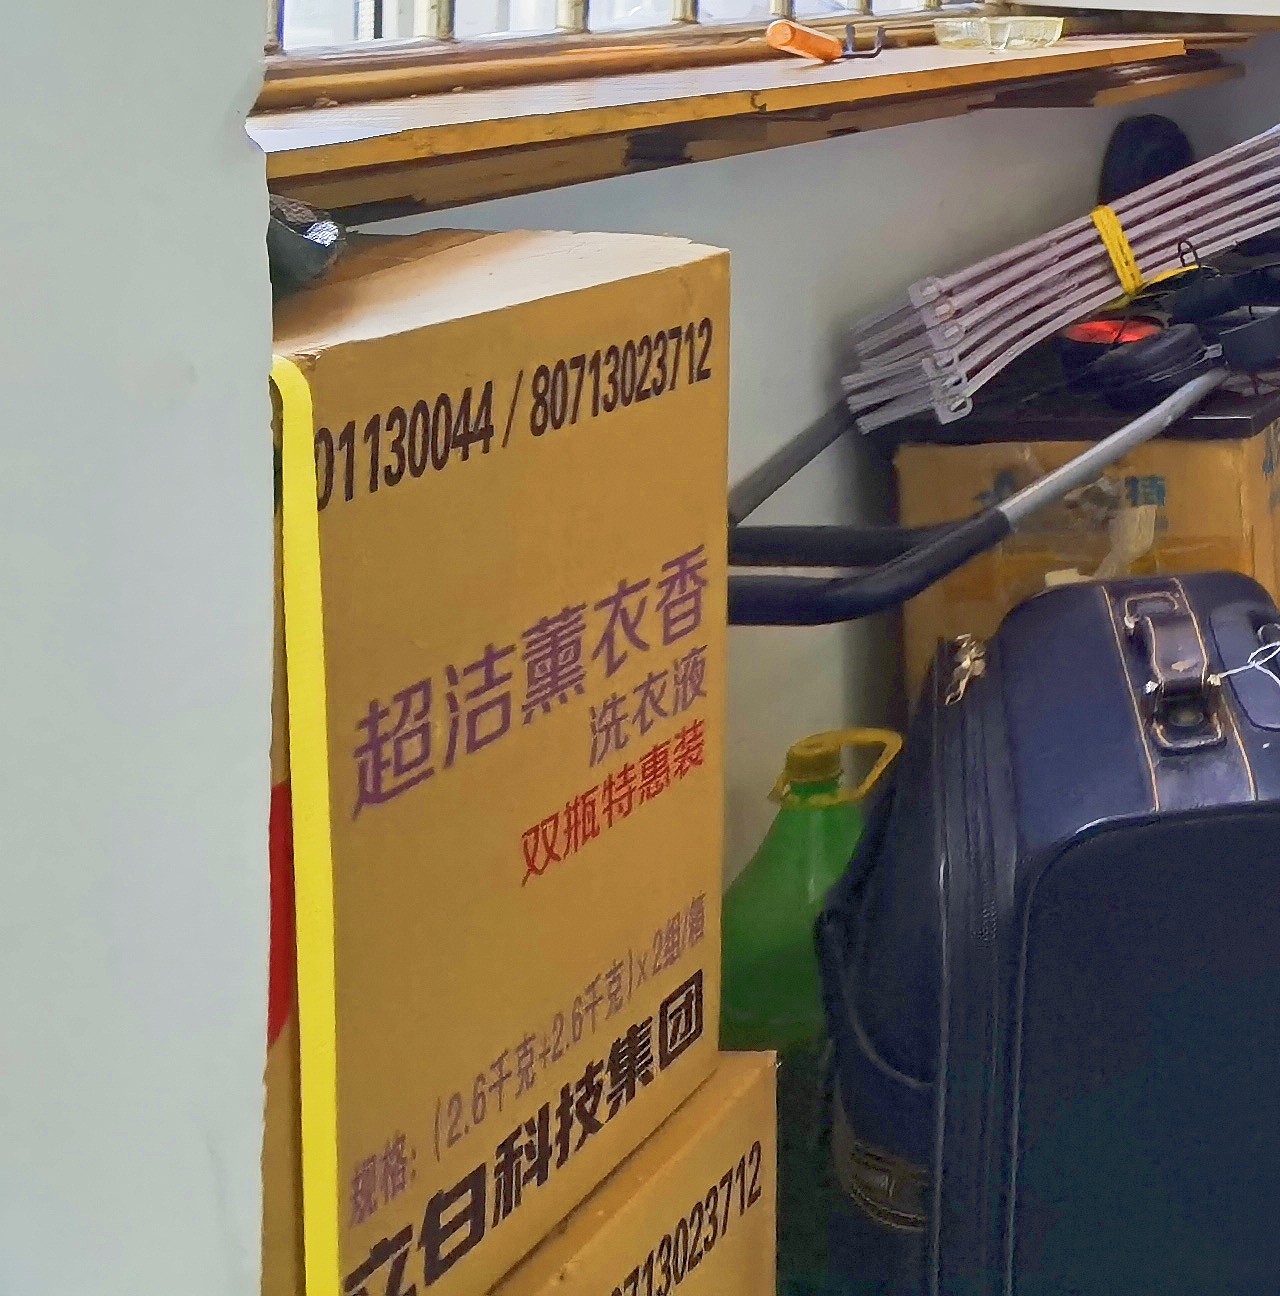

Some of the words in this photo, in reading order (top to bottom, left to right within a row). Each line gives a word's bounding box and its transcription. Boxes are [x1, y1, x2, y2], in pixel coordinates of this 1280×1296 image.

[314, 380, 494, 512] 01130044
[530, 316, 713, 437] 80713023712
[588, 644, 709, 768] 洗衣液
[521, 718, 705, 888] 双瓶特惠装
